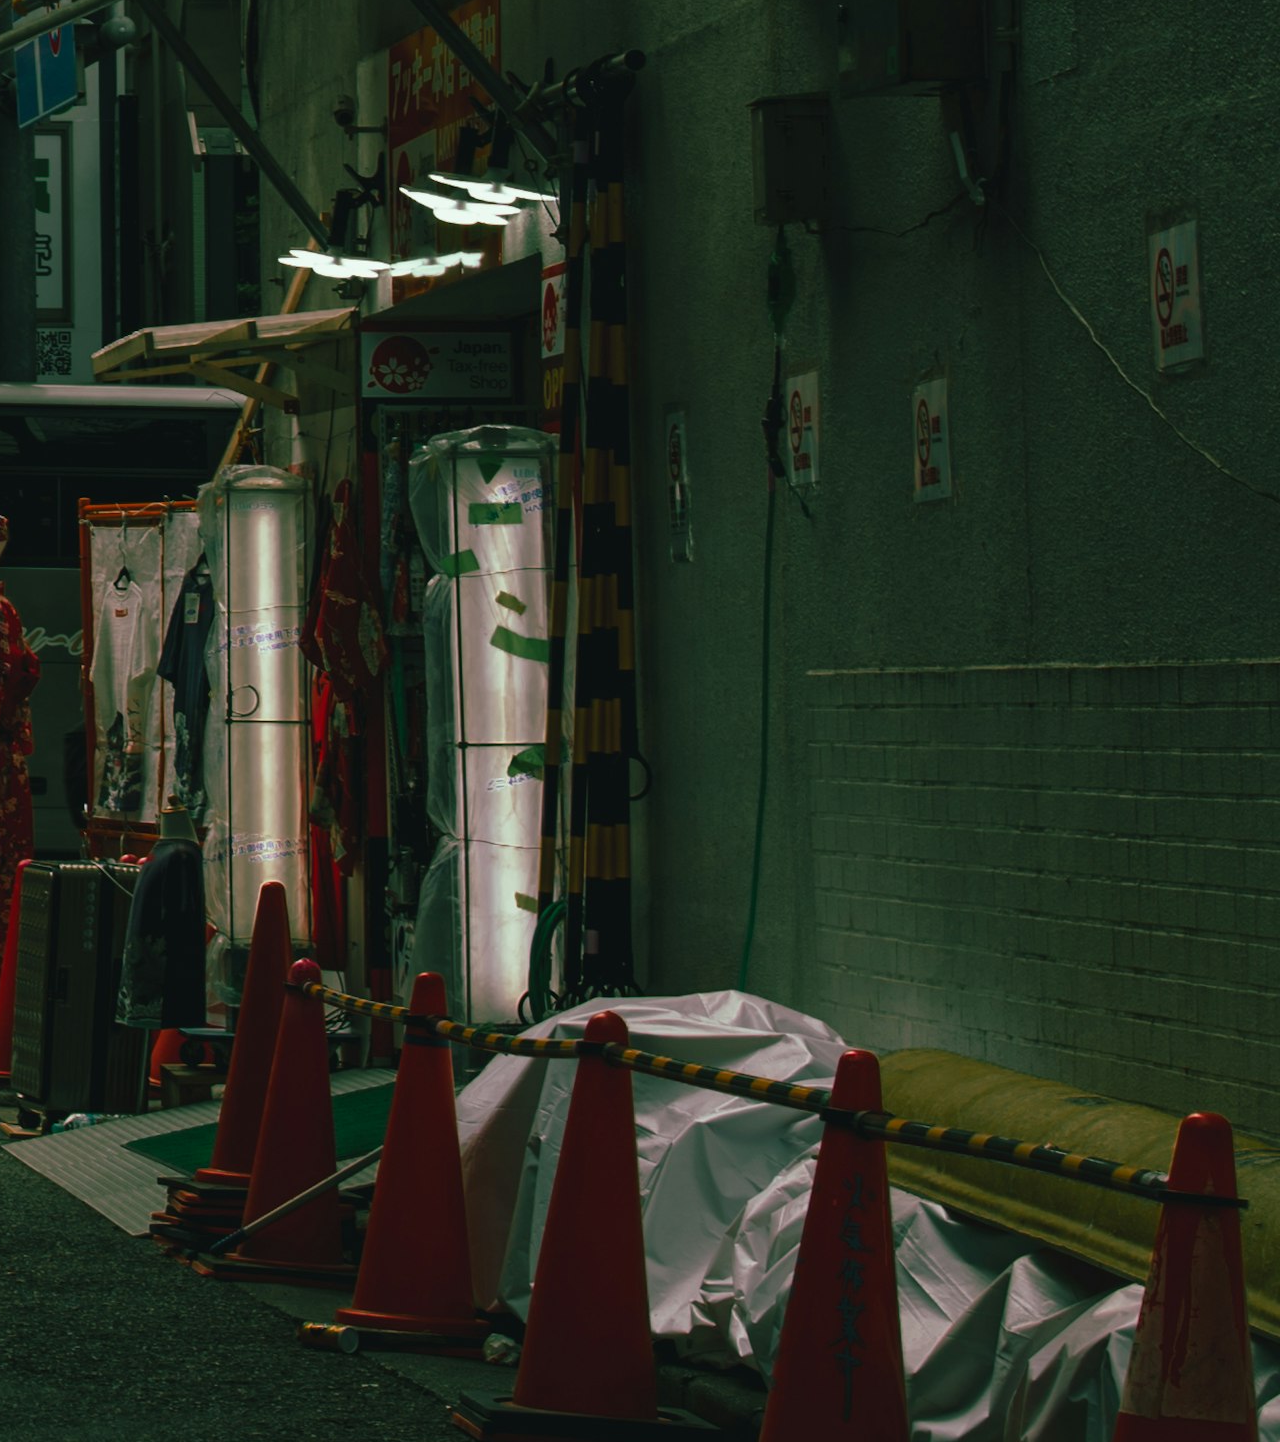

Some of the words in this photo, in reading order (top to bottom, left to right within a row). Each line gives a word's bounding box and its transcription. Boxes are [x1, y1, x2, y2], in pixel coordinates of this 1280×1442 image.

[453, 340, 507, 356] Japan.
[448, 359, 508, 373] Tax-free
[470, 375, 508, 392] Shop
